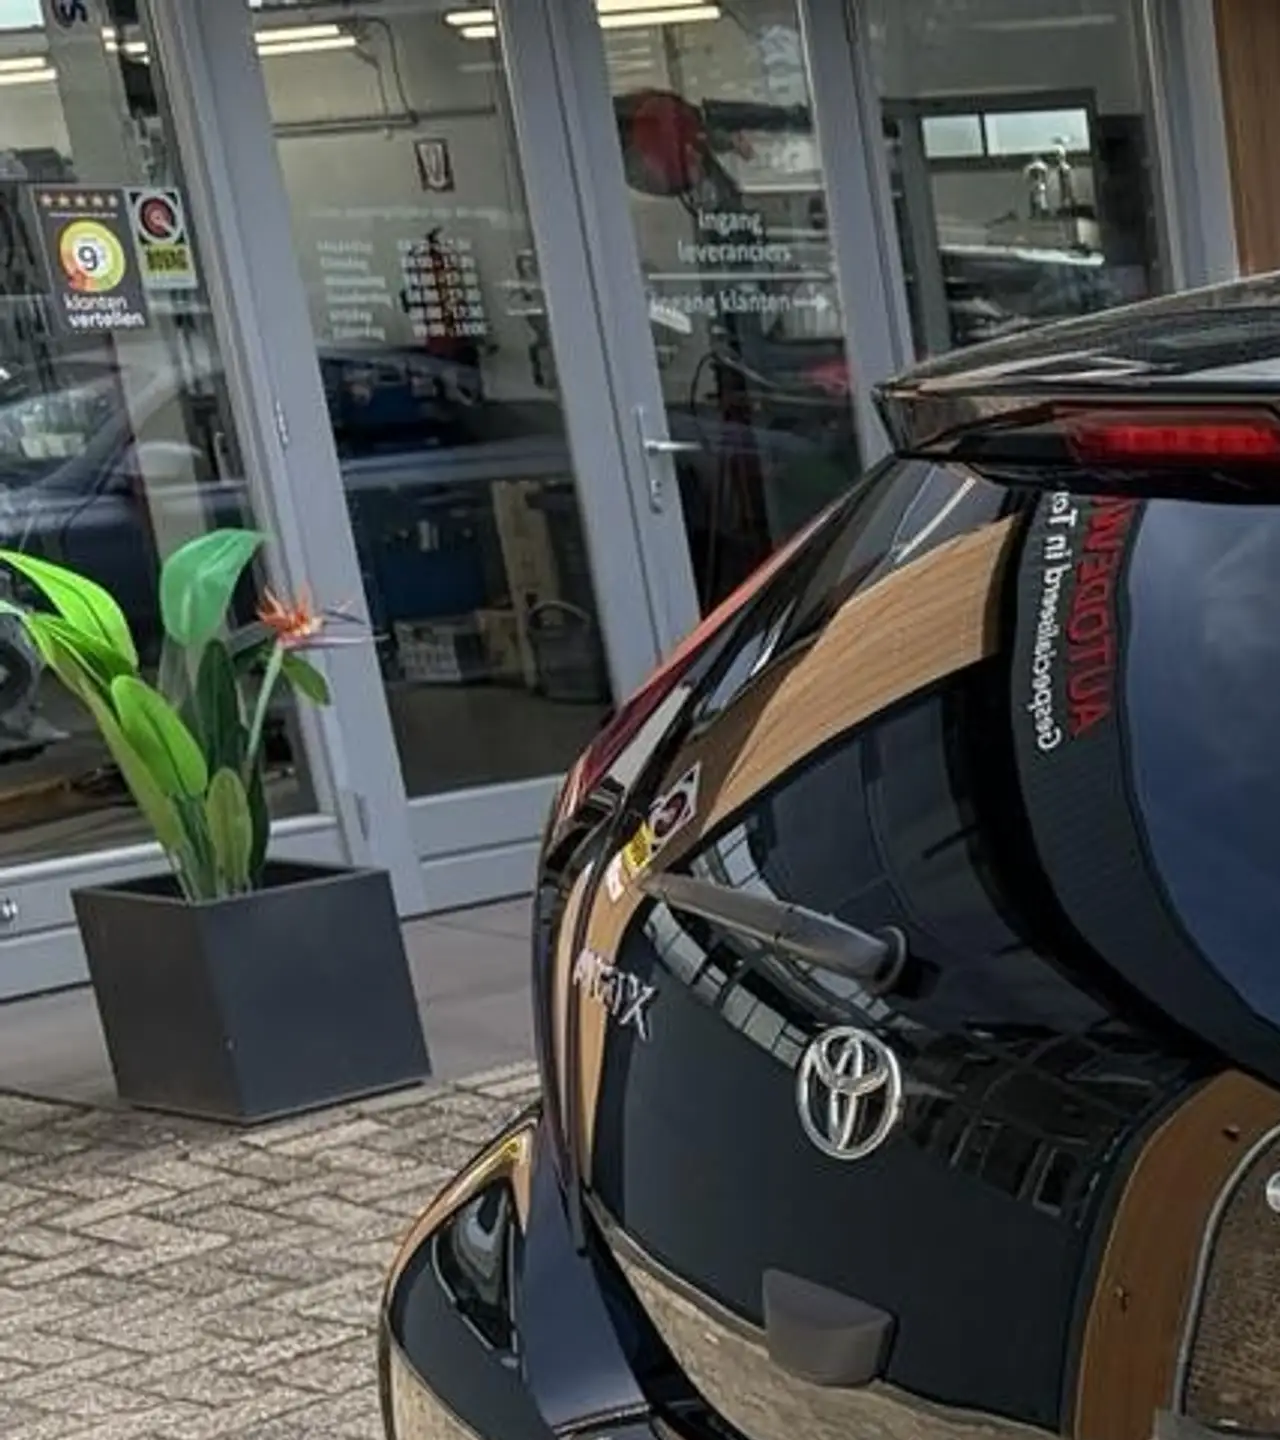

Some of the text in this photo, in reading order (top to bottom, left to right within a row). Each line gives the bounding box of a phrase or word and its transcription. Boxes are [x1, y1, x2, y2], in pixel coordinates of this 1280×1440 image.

[699, 207, 763, 236] Ingang
[677, 240, 792, 263] leveranciers
[720, 288, 790, 314] klanten
